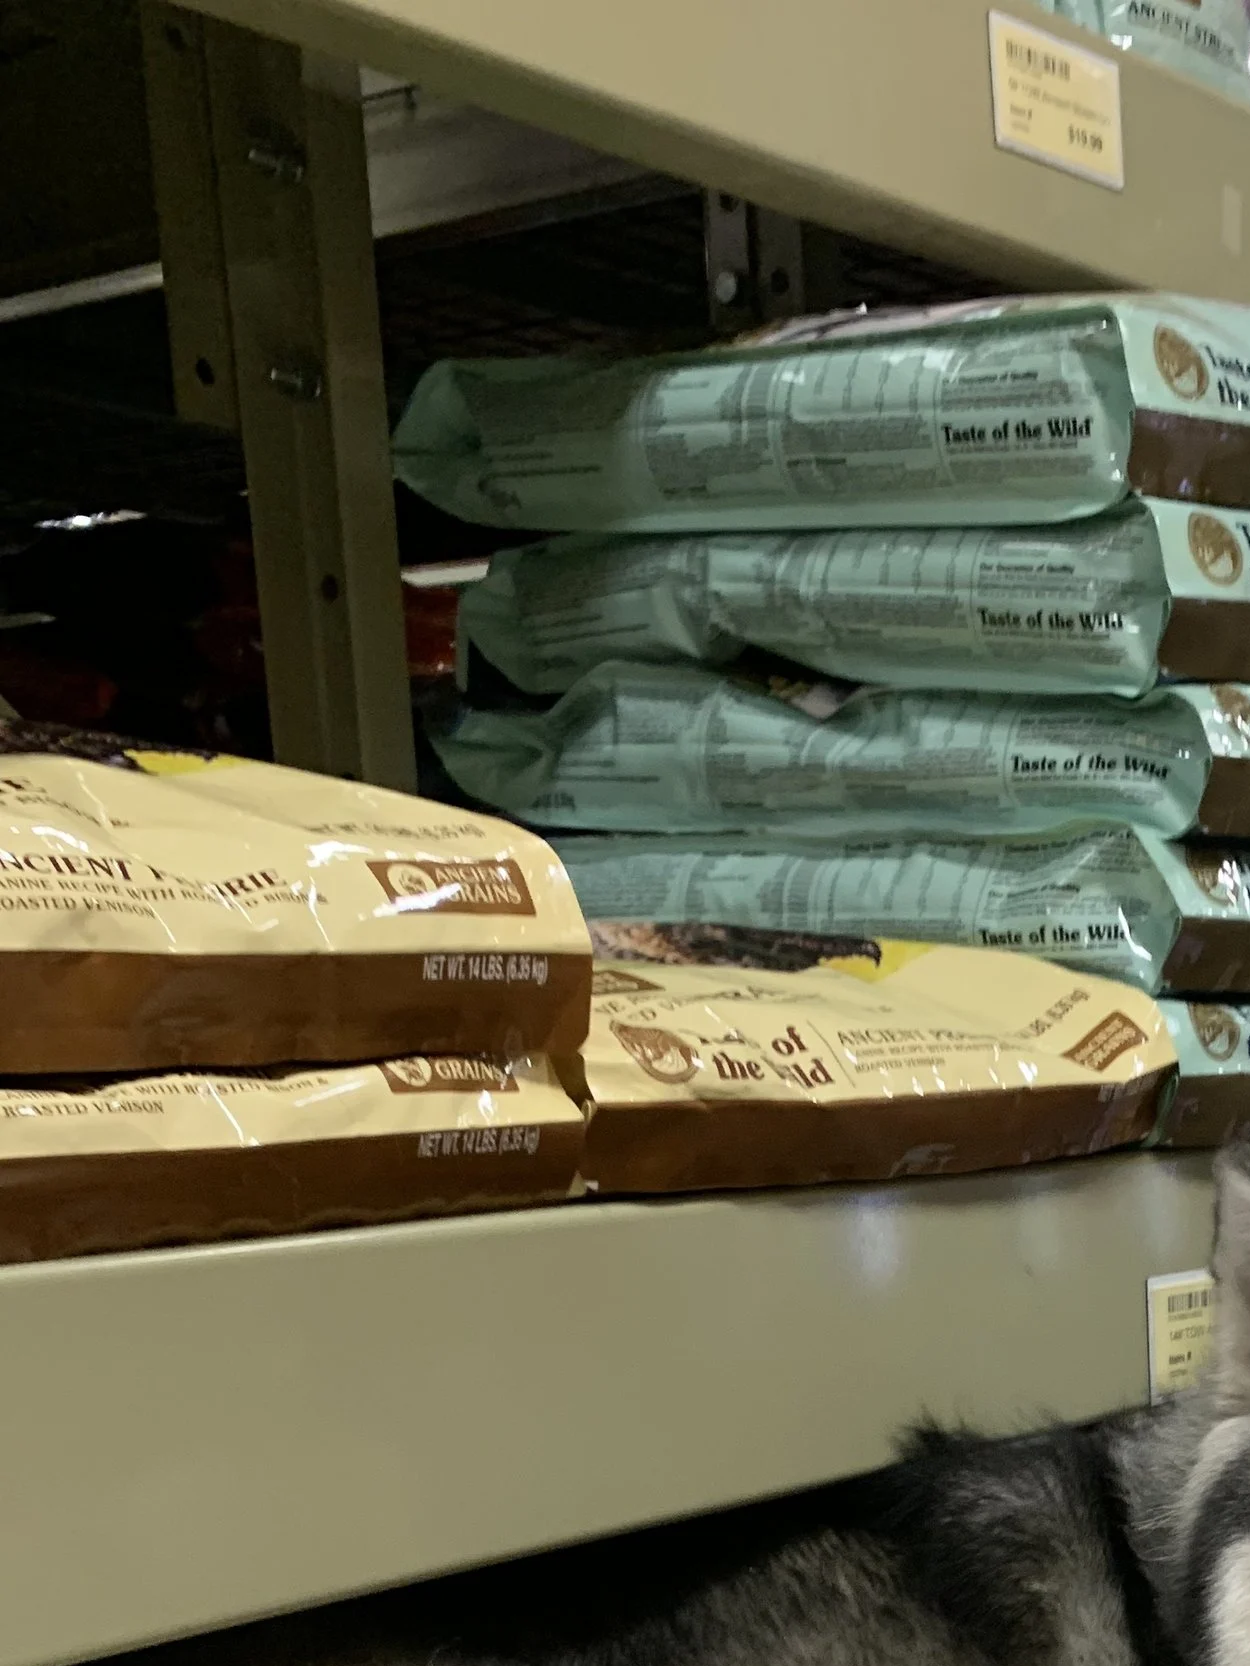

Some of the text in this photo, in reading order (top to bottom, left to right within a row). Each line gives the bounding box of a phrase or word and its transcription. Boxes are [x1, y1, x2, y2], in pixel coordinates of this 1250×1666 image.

[1069, 125, 1102, 152] $19.99
[943, 415, 1094, 444] Taste of the Wild
[978, 606, 1021, 629] Taste
[1026, 607, 1043, 630] of
[1049, 608, 1075, 630] the
[1012, 754, 1169, 779] Taste of the Wild
[0, 853, 132, 881] NCIENT
[0, 879, 51, 891] ANINE
[0, 895, 78, 909] OASTED
[978, 928, 1022, 945] Taste
[1029, 926, 1046, 945] of
[1053, 925, 1081, 942] the
[423, 956, 444, 981] NET
[449, 956, 466, 980] WT.
[468, 956, 481, 980] 14
[482, 956, 504, 981] LBS.
[771, 1024, 808, 1056] of
[836, 1027, 925, 1045] ANCIENT
[435, 1059, 505, 1082] GRAINS
[712, 1050, 766, 1080] the
